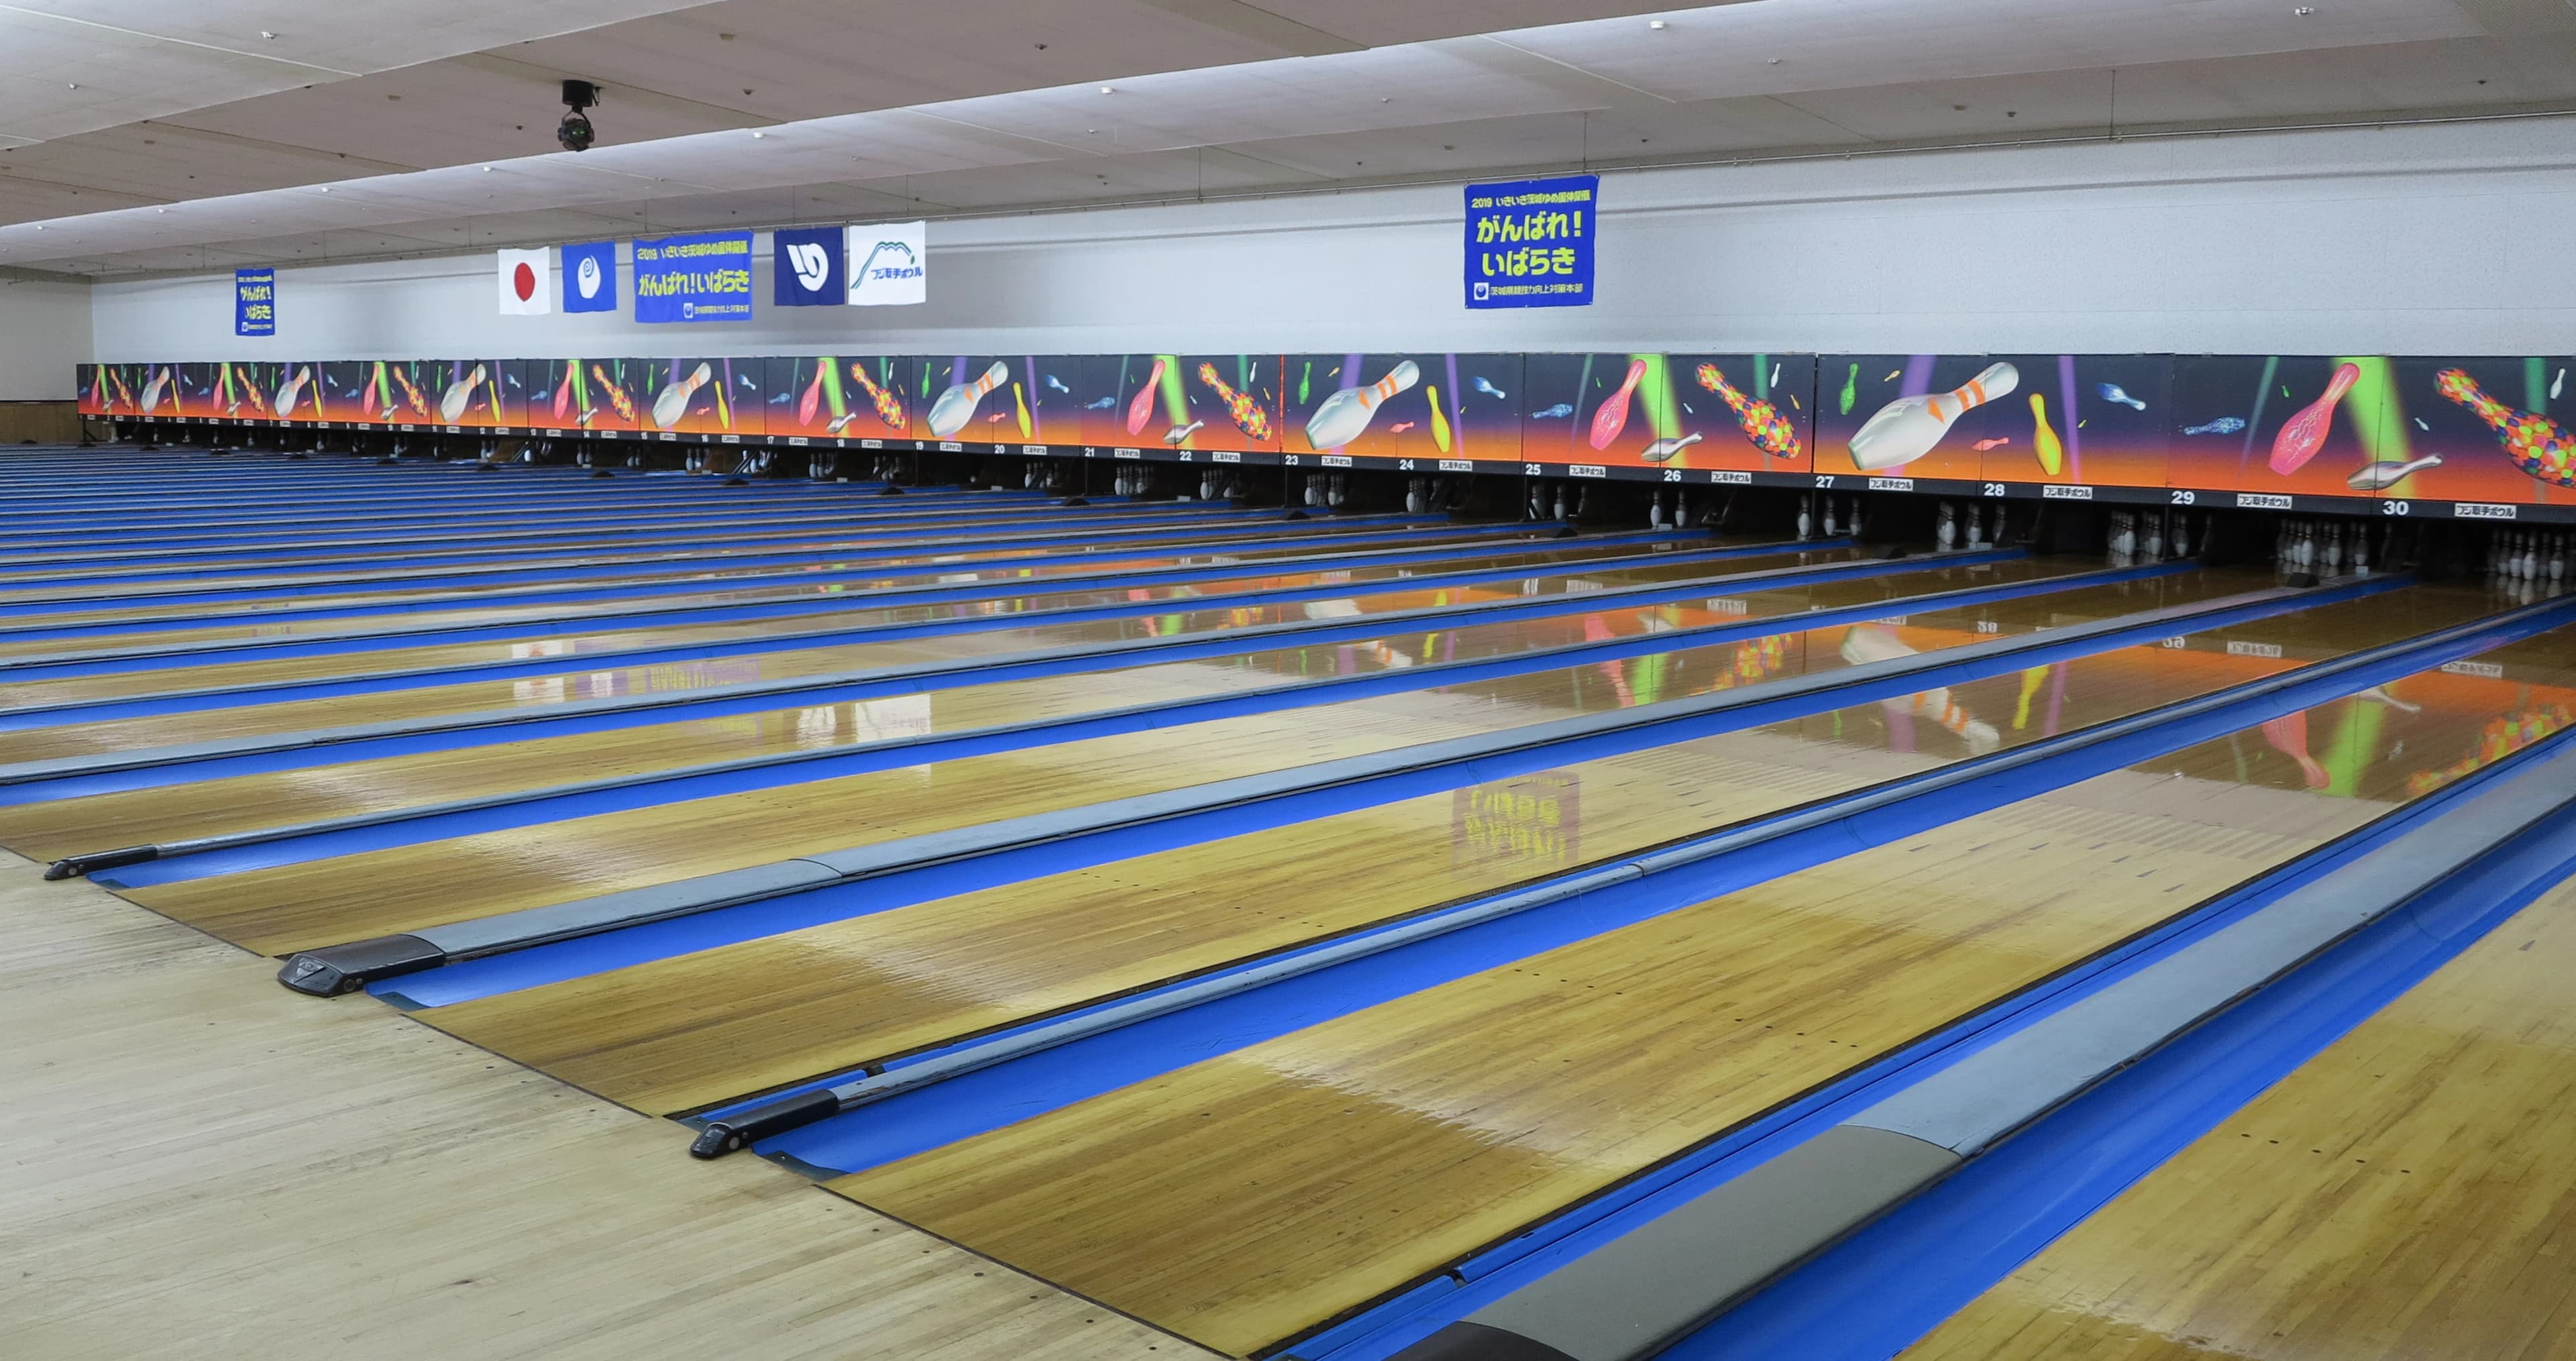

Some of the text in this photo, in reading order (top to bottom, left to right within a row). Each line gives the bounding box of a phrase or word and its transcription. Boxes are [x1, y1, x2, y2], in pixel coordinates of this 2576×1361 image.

[1471, 198, 1493, 208] 2019
[1476, 211, 1582, 243] がんばれ!
[637, 248, 657, 260] 2019
[1482, 247, 1575, 276] いばらき
[641, 431, 648, 440] 15
[915, 441, 924, 450] 19
[994, 444, 1005, 454] 20
[1084, 447, 1095, 457] 21
[1179, 451, 1192, 461] 22
[1285, 455, 1299, 466] 23
[1399, 459, 1414, 470] 24
[1525, 464, 1542, 476] 25
[1664, 470, 1682, 482] 26
[1815, 476, 1835, 488] 27
[1984, 482, 2005, 497] 28
[2171, 490, 2195, 505] 29
[2382, 500, 2409, 516] 30
